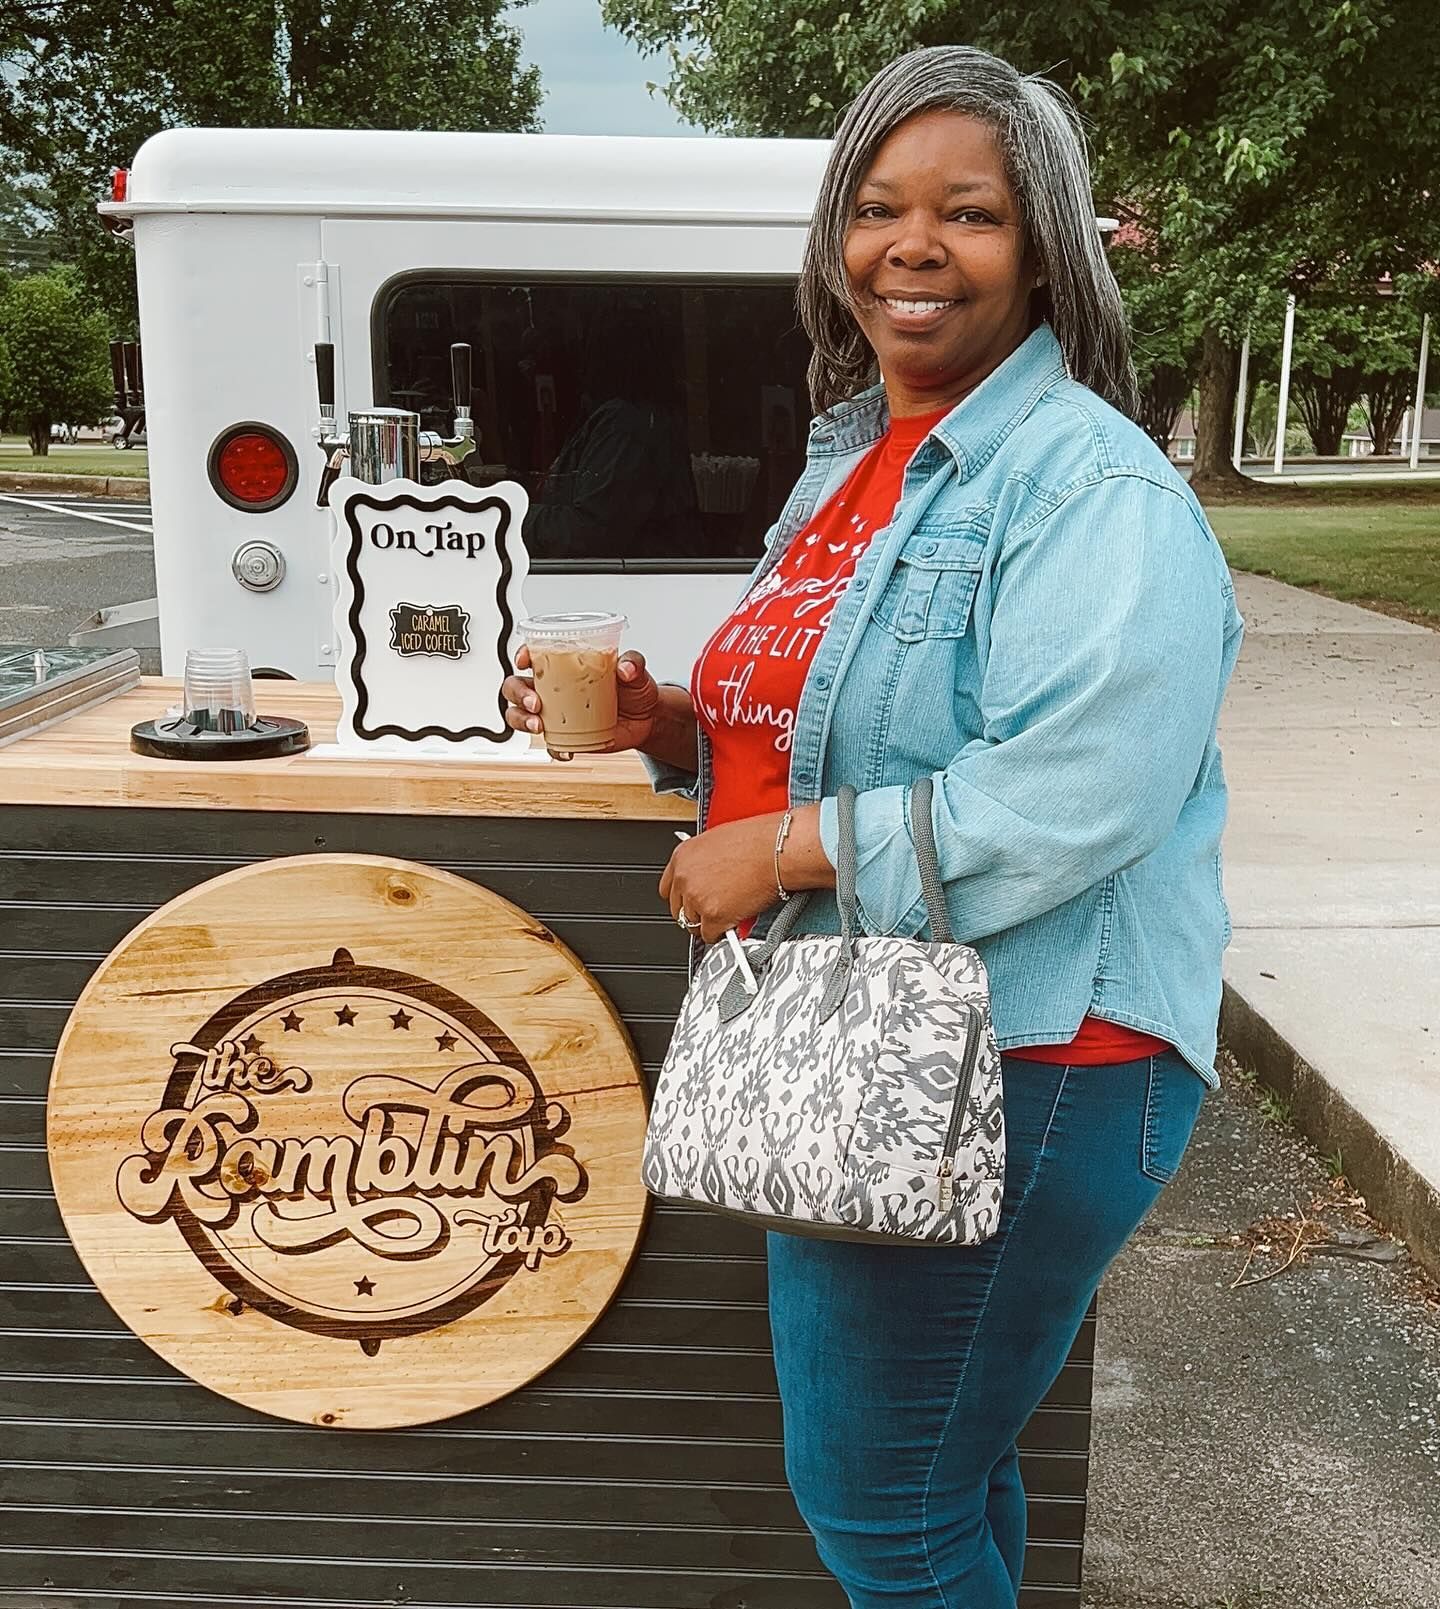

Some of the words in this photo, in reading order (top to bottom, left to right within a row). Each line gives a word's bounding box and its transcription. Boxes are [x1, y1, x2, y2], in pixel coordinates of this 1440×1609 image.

[371, 523, 434, 557] On
[425, 521, 485, 559] Tap
[400, 633, 422, 651] ICED
[425, 633, 459, 652] COFFEE
[411, 614, 450, 633] CARAMEL
[717, 623, 746, 653] IN
[735, 624, 777, 656] THE
[768, 625, 828, 661] LIT
[115, 1061, 589, 1262] Ramblin'
